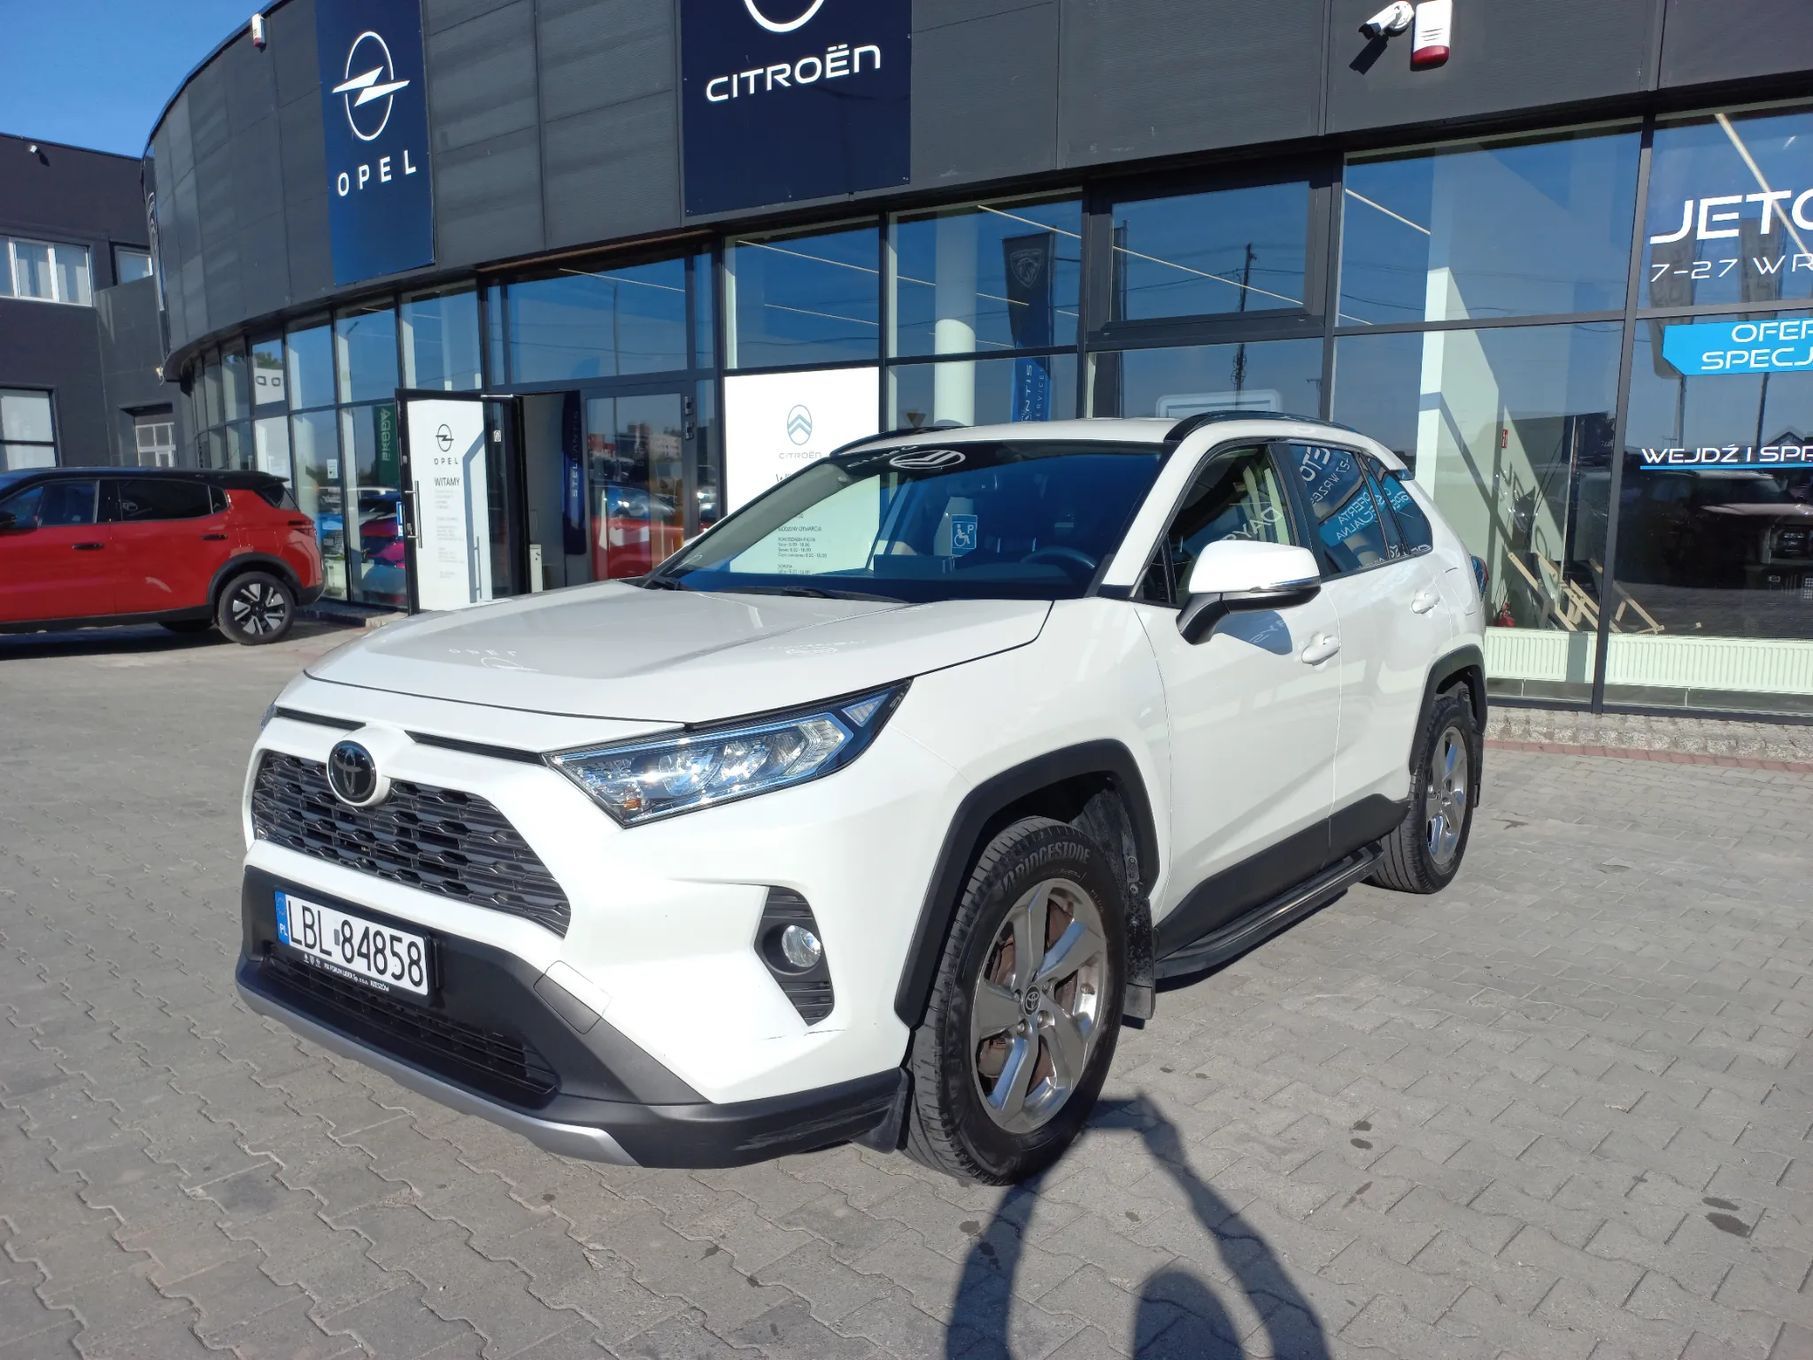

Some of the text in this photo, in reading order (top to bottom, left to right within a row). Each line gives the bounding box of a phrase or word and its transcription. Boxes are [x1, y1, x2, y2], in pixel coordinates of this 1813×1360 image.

[337, 149, 417, 197] OPEL
[1650, 258, 1738, 283] 7-27
[433, 457, 459, 465] OPEL
[1641, 443, 1740, 464] WEJDŹ
[1746, 446, 1752, 462] I
[434, 477, 460, 487] WITAMY
[967, 524, 974, 534] P
[1001, 841, 1091, 892] BRIDGESTONE
[279, 922, 289, 937] PL
[288, 900, 424, 988] LBL 84858
